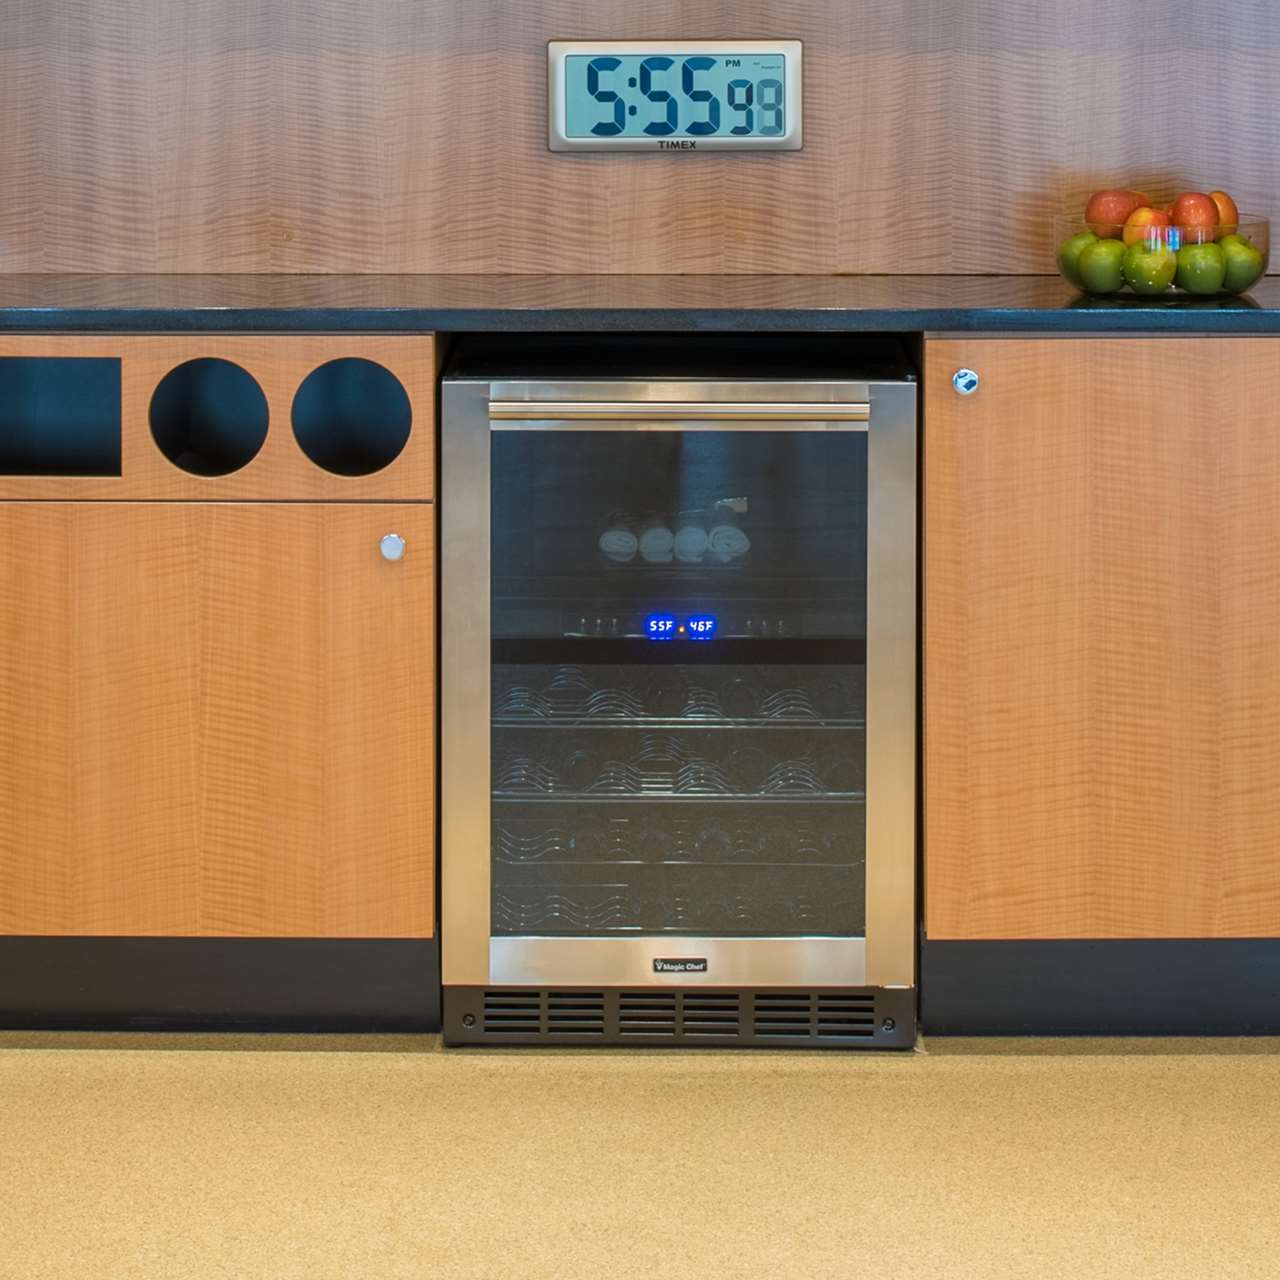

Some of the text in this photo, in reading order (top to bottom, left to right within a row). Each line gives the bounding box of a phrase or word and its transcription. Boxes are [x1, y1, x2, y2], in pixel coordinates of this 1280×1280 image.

[586, 56, 741, 136] 5:55 PM
[657, 140, 697, 150] TIMEX
[649, 621, 713, 631] 55F 46F
[662, 963, 685, 971] Magic
